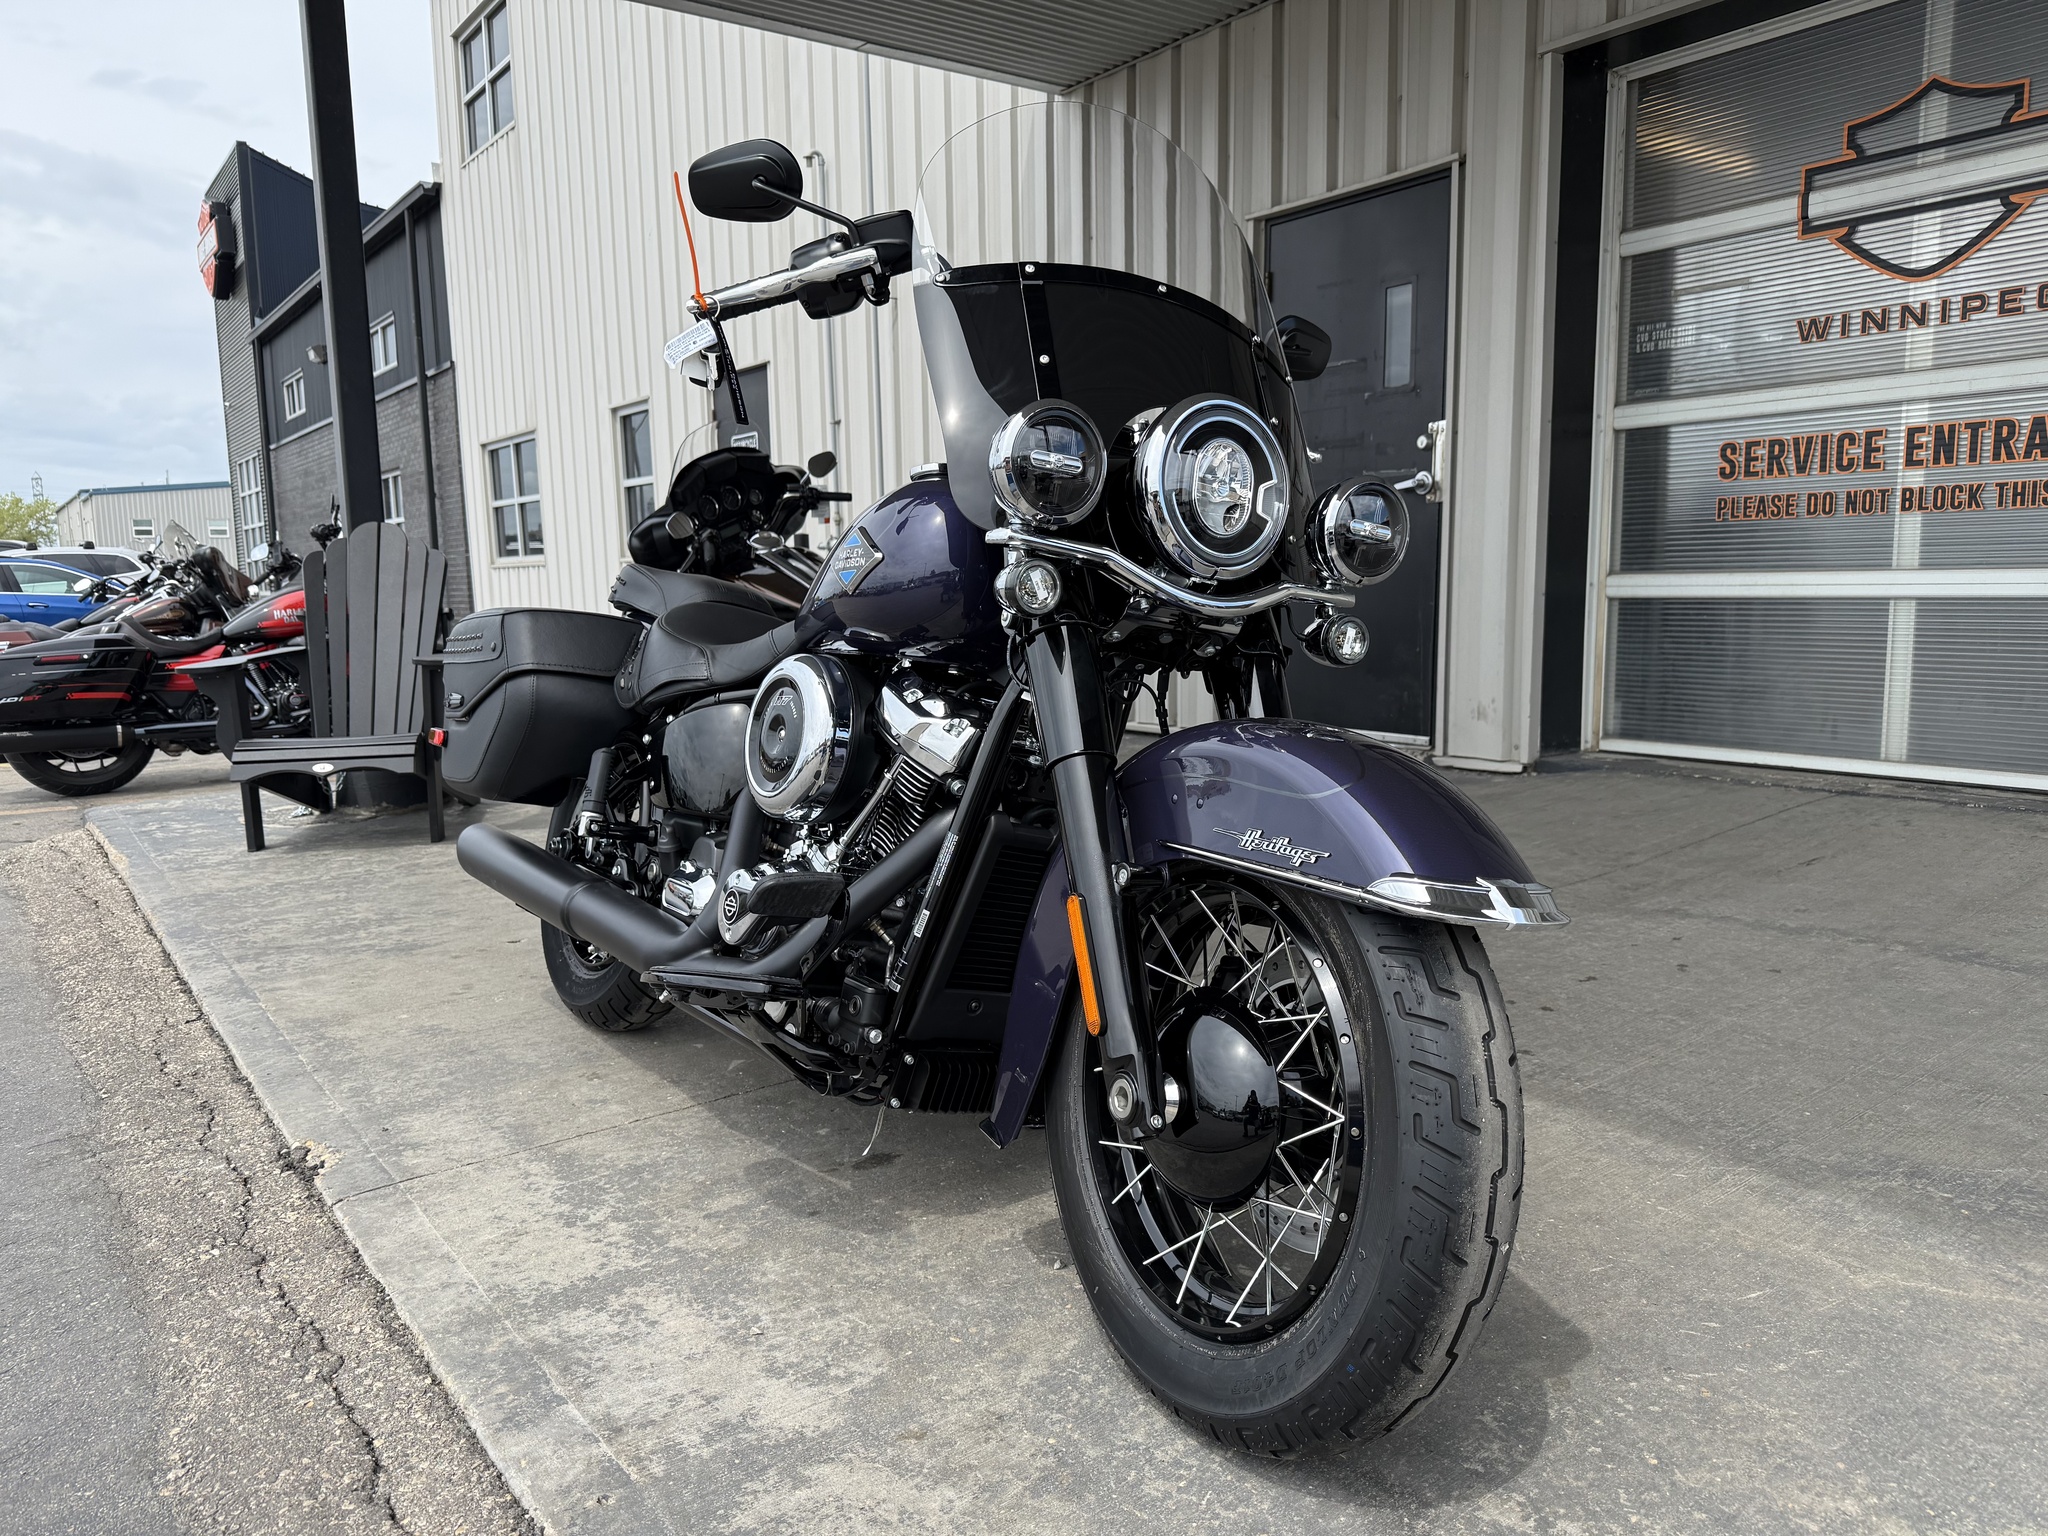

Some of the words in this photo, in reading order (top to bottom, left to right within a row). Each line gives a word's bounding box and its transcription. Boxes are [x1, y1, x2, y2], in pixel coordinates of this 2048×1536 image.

[1717, 427, 1888, 482] SERVICE
[1715, 492, 1798, 522] PLEASE
[1805, 489, 1837, 518] DO
[1843, 486, 1892, 516] NOT
[1899, 481, 1986, 513] BLOCK
[834, 556, 866, 570] DAVIDSON
